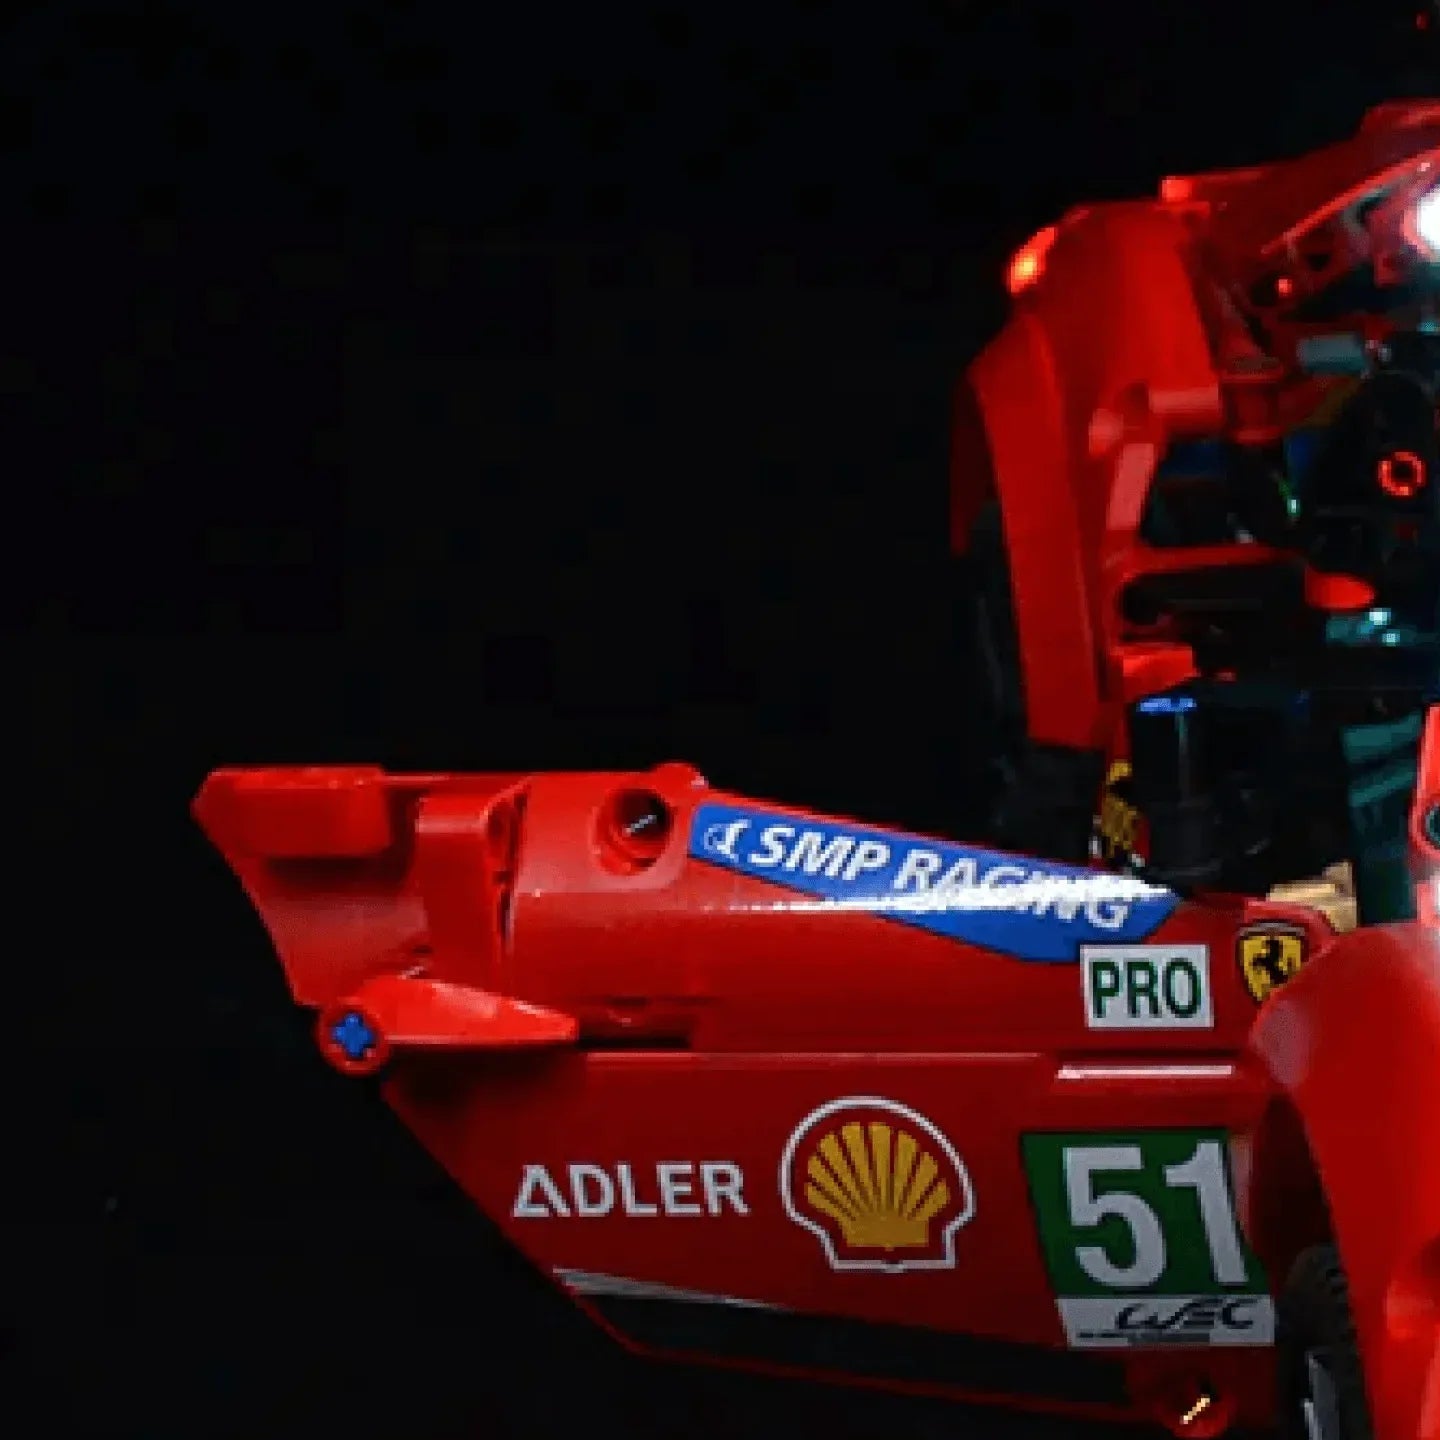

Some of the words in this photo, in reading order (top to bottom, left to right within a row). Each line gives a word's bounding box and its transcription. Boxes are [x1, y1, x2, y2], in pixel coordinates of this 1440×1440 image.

[750, 826, 891, 881] SMP
[1090, 960, 1202, 1019] PRO
[513, 1161, 750, 1218] ADLER
[1062, 1139, 1250, 1287] 51
